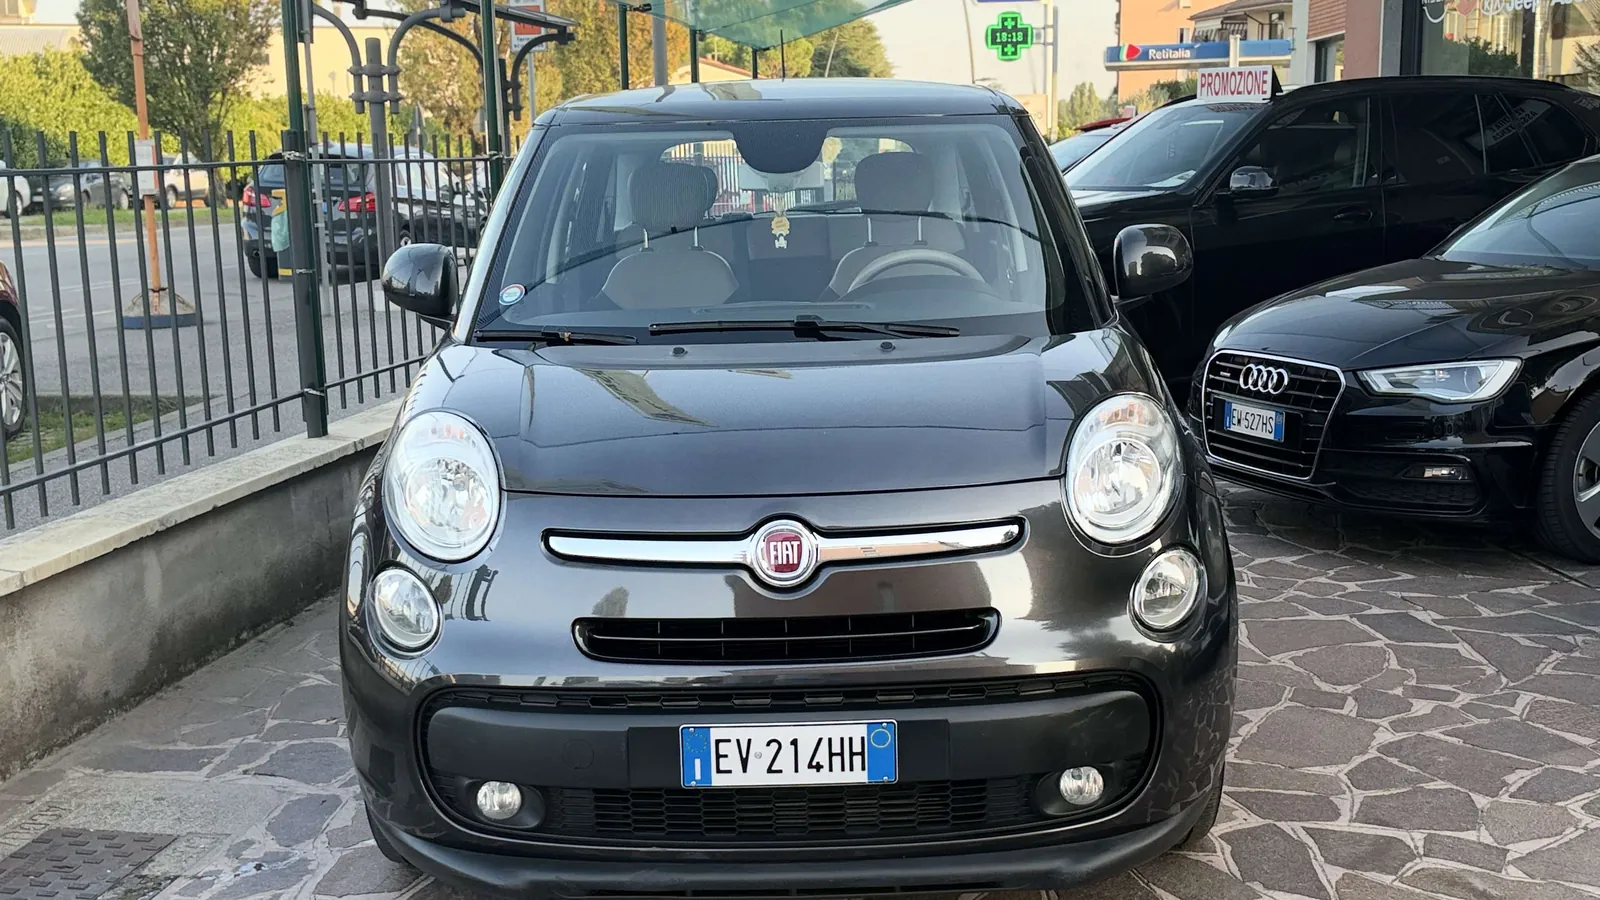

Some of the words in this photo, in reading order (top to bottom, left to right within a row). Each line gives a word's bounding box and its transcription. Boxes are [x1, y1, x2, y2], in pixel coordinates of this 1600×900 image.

[996, 32, 1023, 42] 18:18
[1148, 48, 1190, 60] Retitalia
[1200, 70, 1268, 96] PROMOZIONE
[769, 541, 800, 565] FIAT
